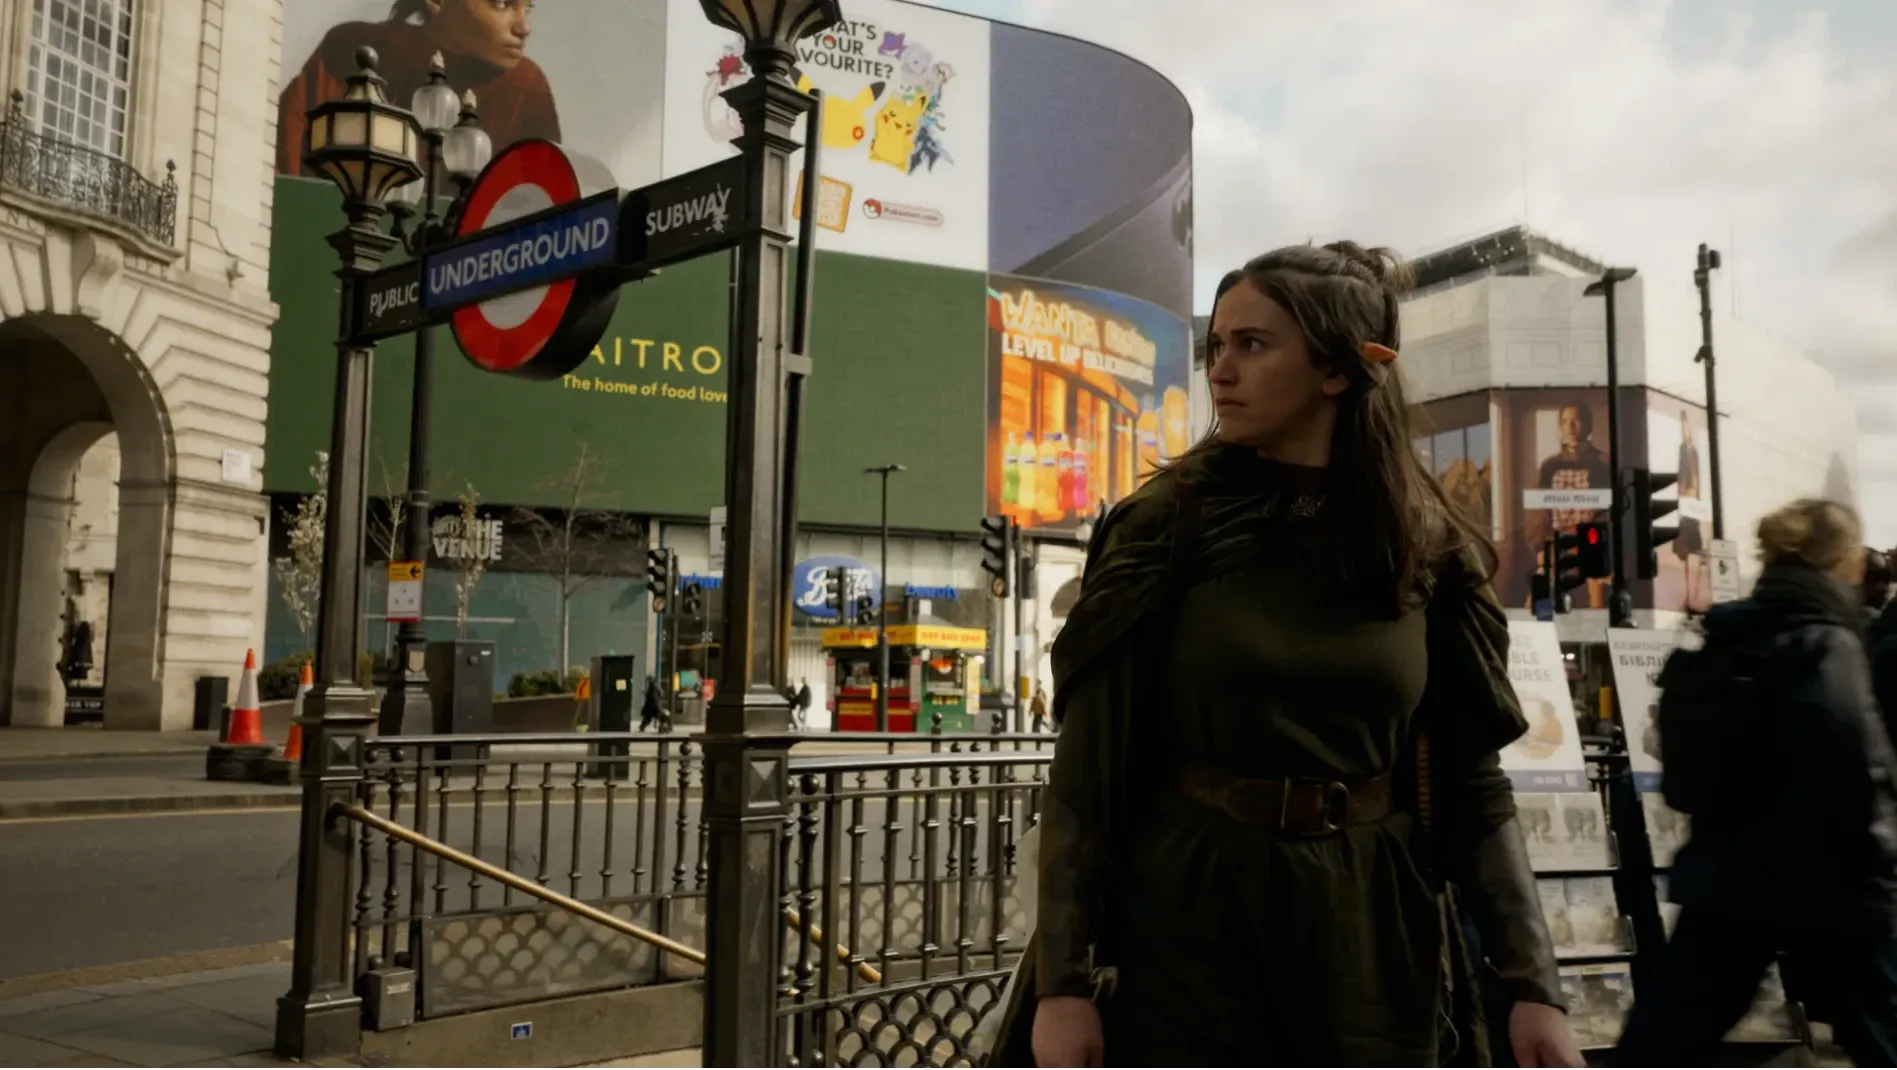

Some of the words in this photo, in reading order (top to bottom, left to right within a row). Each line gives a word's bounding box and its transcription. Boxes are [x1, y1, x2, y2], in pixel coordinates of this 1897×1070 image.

[813, 33, 864, 56] YOUR
[831, 20, 877, 40] AT'S
[801, 48, 893, 79] VOURITE?
[645, 187, 731, 237] SUBWAY
[430, 217, 610, 295] UNDERGROUND
[369, 281, 420, 314] PUBLIC
[590, 336, 722, 376] AITRO
[1002, 331, 1057, 362] LEVEL
[563, 373, 591, 391] The
[595, 377, 638, 396] home
[641, 381, 658, 397] of
[661, 383, 697, 401] food
[700, 387, 728, 403] love
[433, 537, 503, 560] VENUE
[796, 565, 874, 607] Bts
[1510, 650, 1541, 665] BLE
[1511, 668, 1553, 682] URSE
